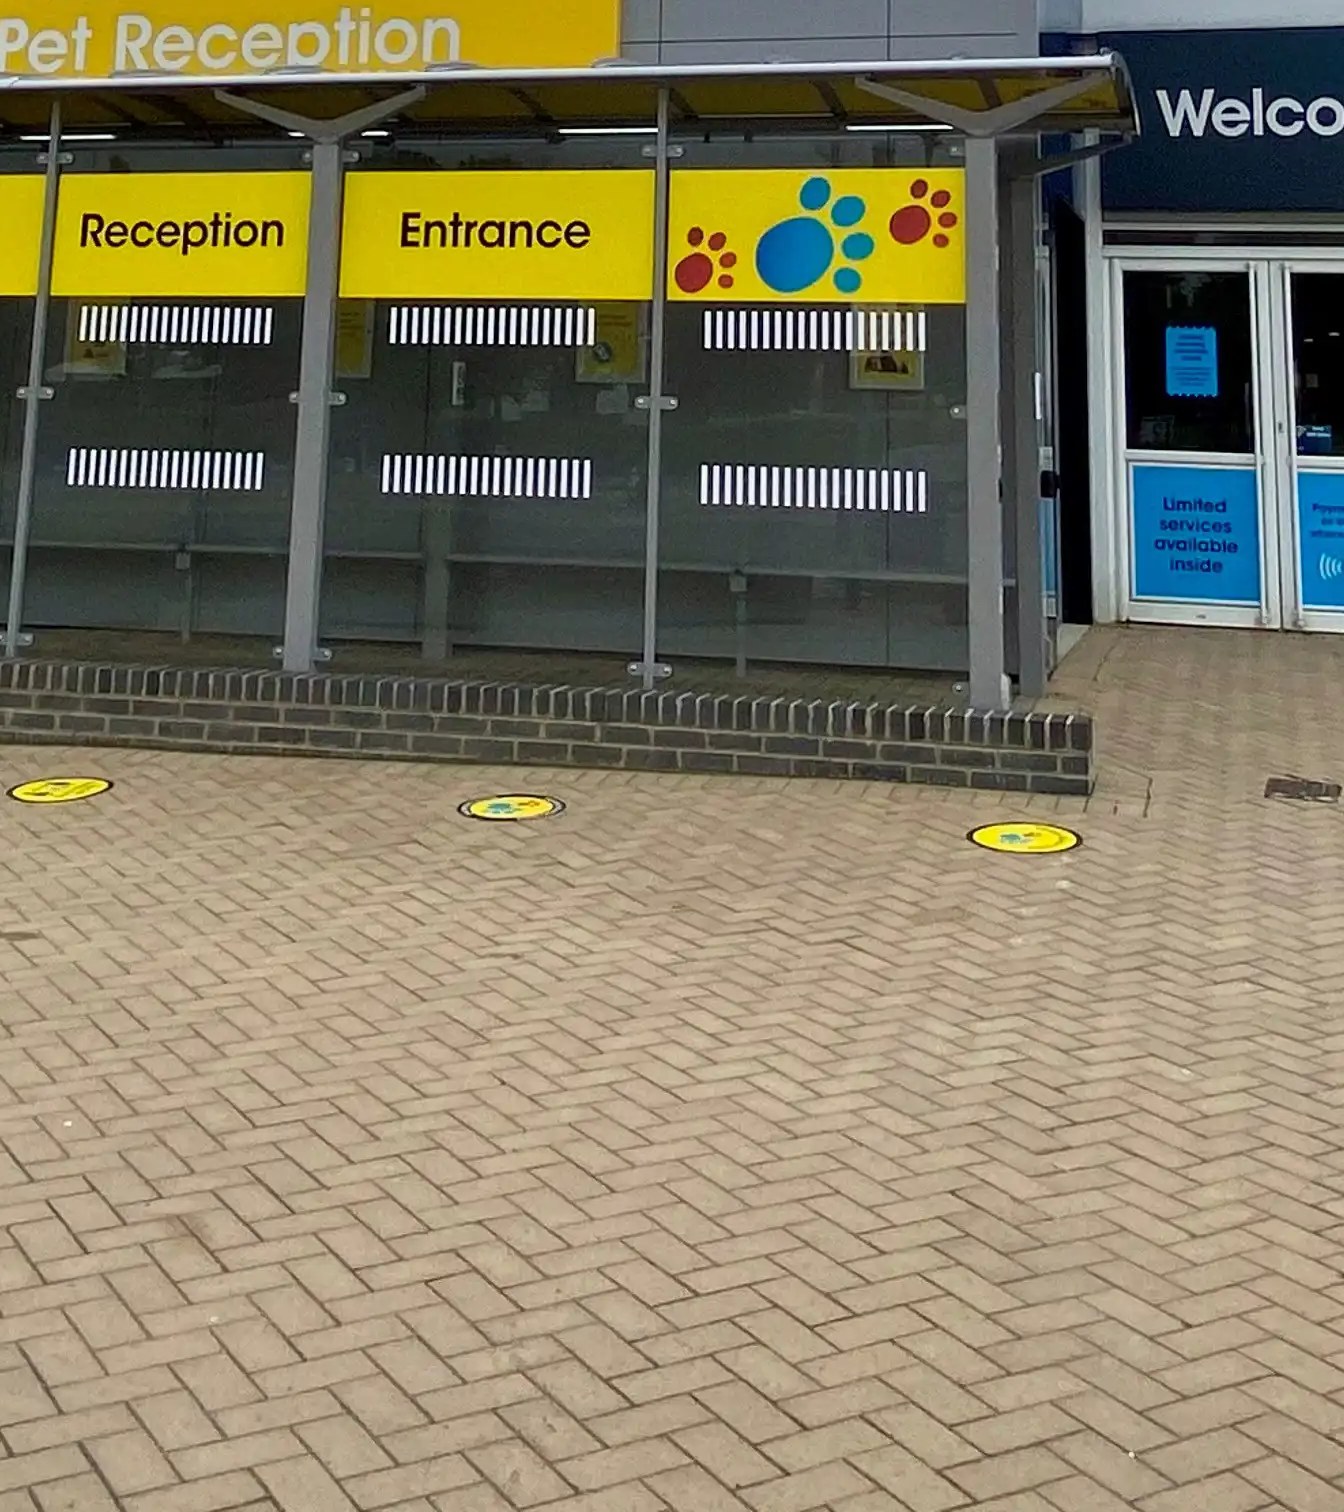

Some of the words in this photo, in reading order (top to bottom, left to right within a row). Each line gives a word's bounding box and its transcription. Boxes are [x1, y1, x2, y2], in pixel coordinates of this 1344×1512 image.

[115, 7, 462, 71] Reception
[80, 211, 285, 256] Reception
[400, 211, 592, 249] Entrance
[1162, 497, 1227, 514] Limited
[1159, 518, 1232, 534] services
[1154, 539, 1238, 555] available
[1169, 558, 1223, 574] inside
